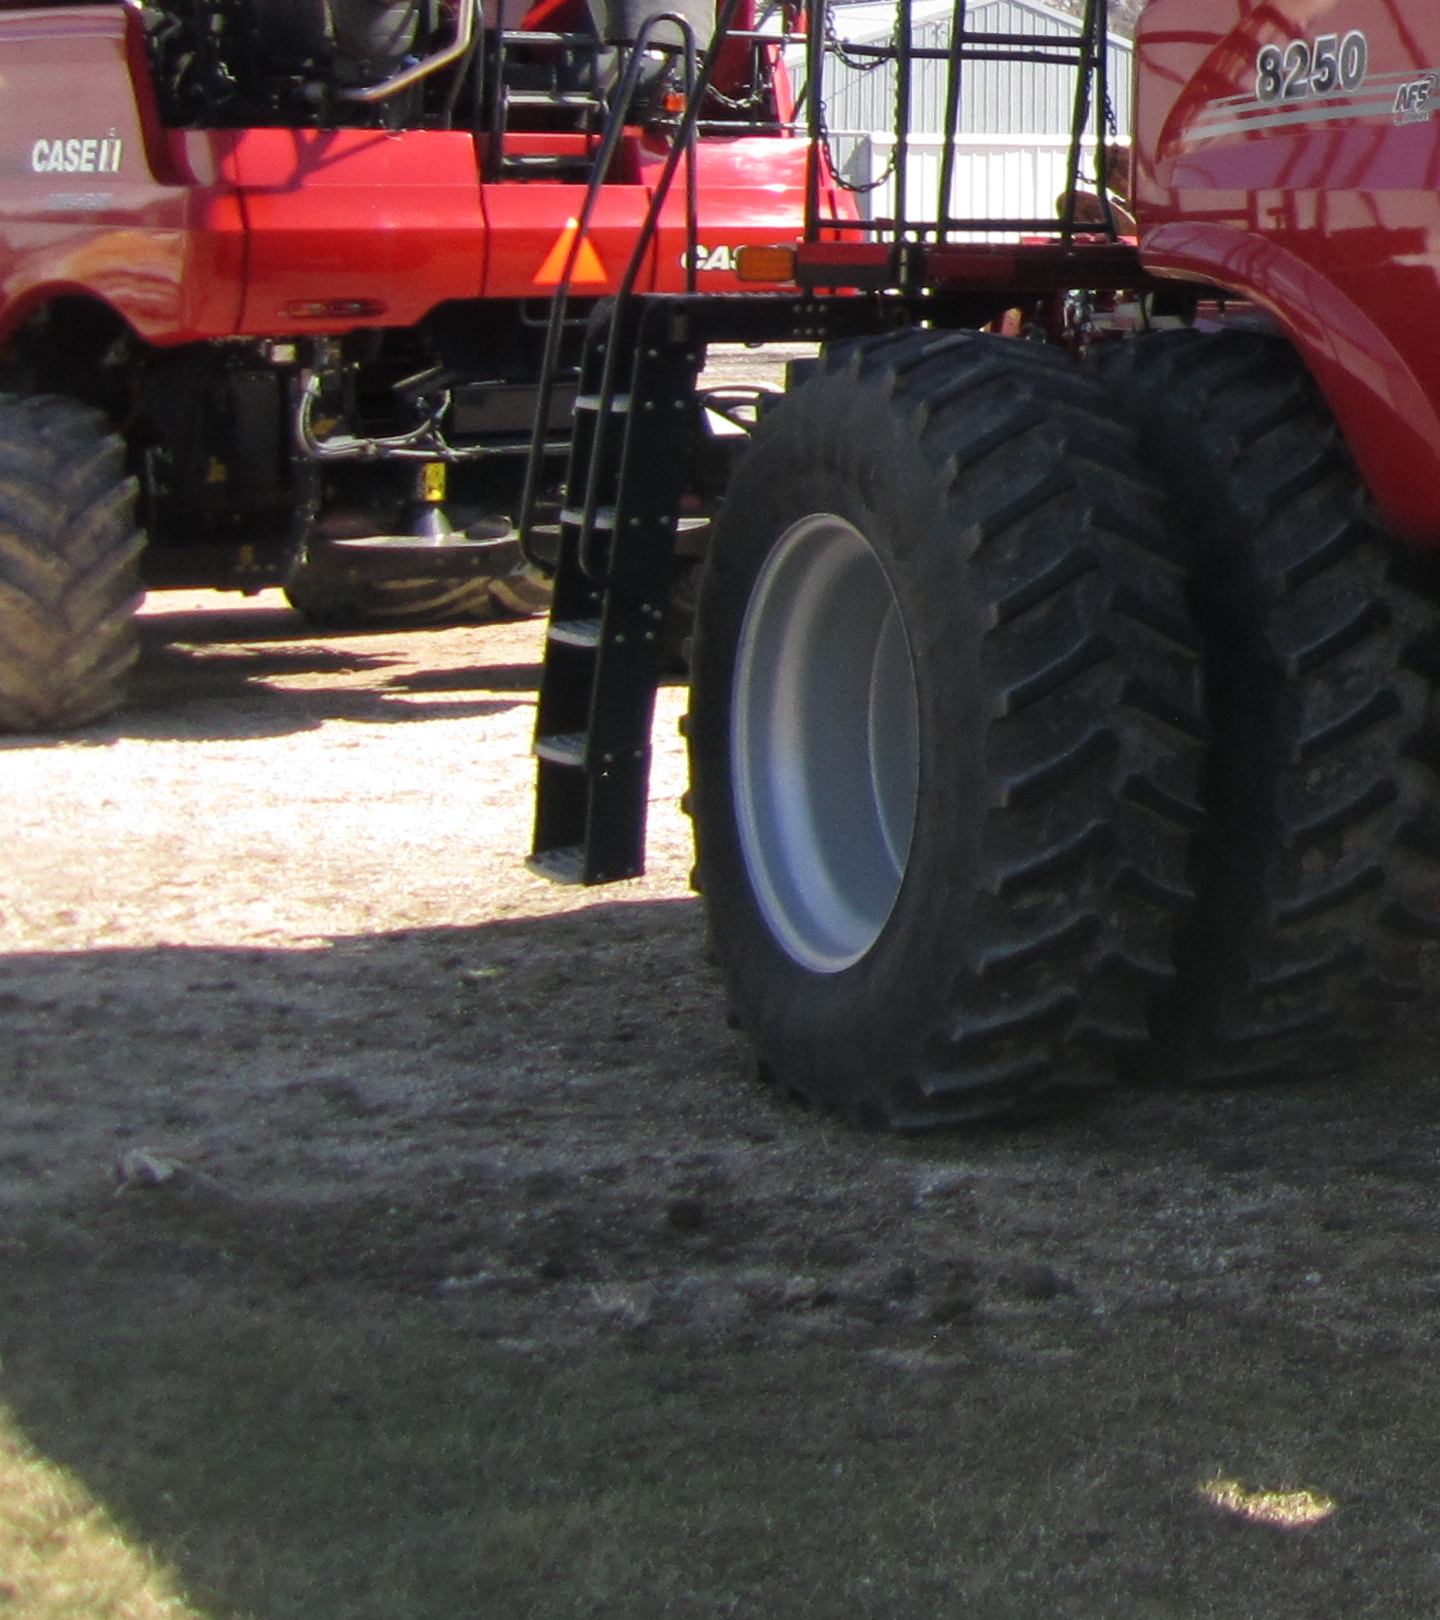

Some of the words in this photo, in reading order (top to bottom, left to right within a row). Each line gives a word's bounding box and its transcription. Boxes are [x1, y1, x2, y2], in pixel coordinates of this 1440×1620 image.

[1256, 30, 1367, 104] 8250
[1392, 79, 1431, 114] AFS
[32, 138, 98, 173] CASE
